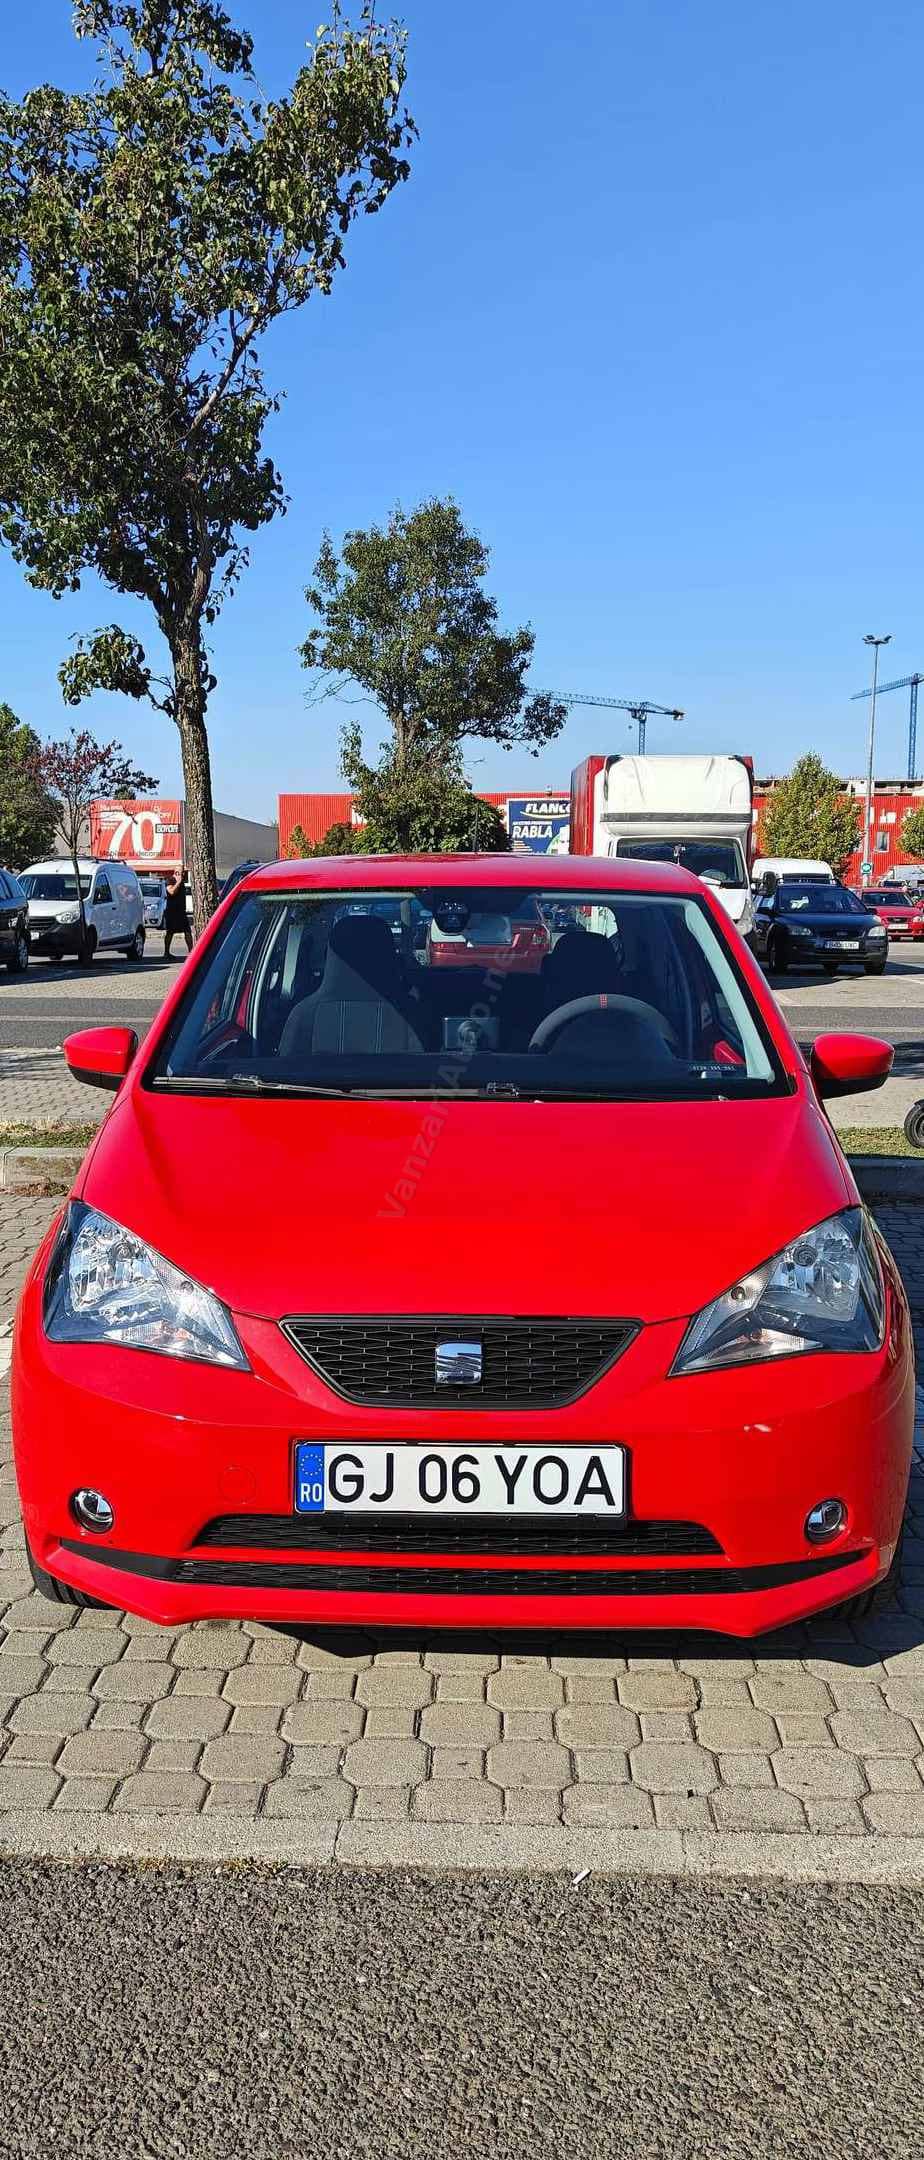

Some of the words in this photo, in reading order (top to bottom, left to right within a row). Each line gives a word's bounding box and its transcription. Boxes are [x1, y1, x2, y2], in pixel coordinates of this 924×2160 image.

[100, 810, 164, 859] 70
[512, 825, 553, 838] RABLA
[301, 1484, 322, 1503] RO
[328, 1453, 394, 1504] GJ
[418, 1454, 480, 1505] 06
[494, 1455, 616, 1507] YOA
